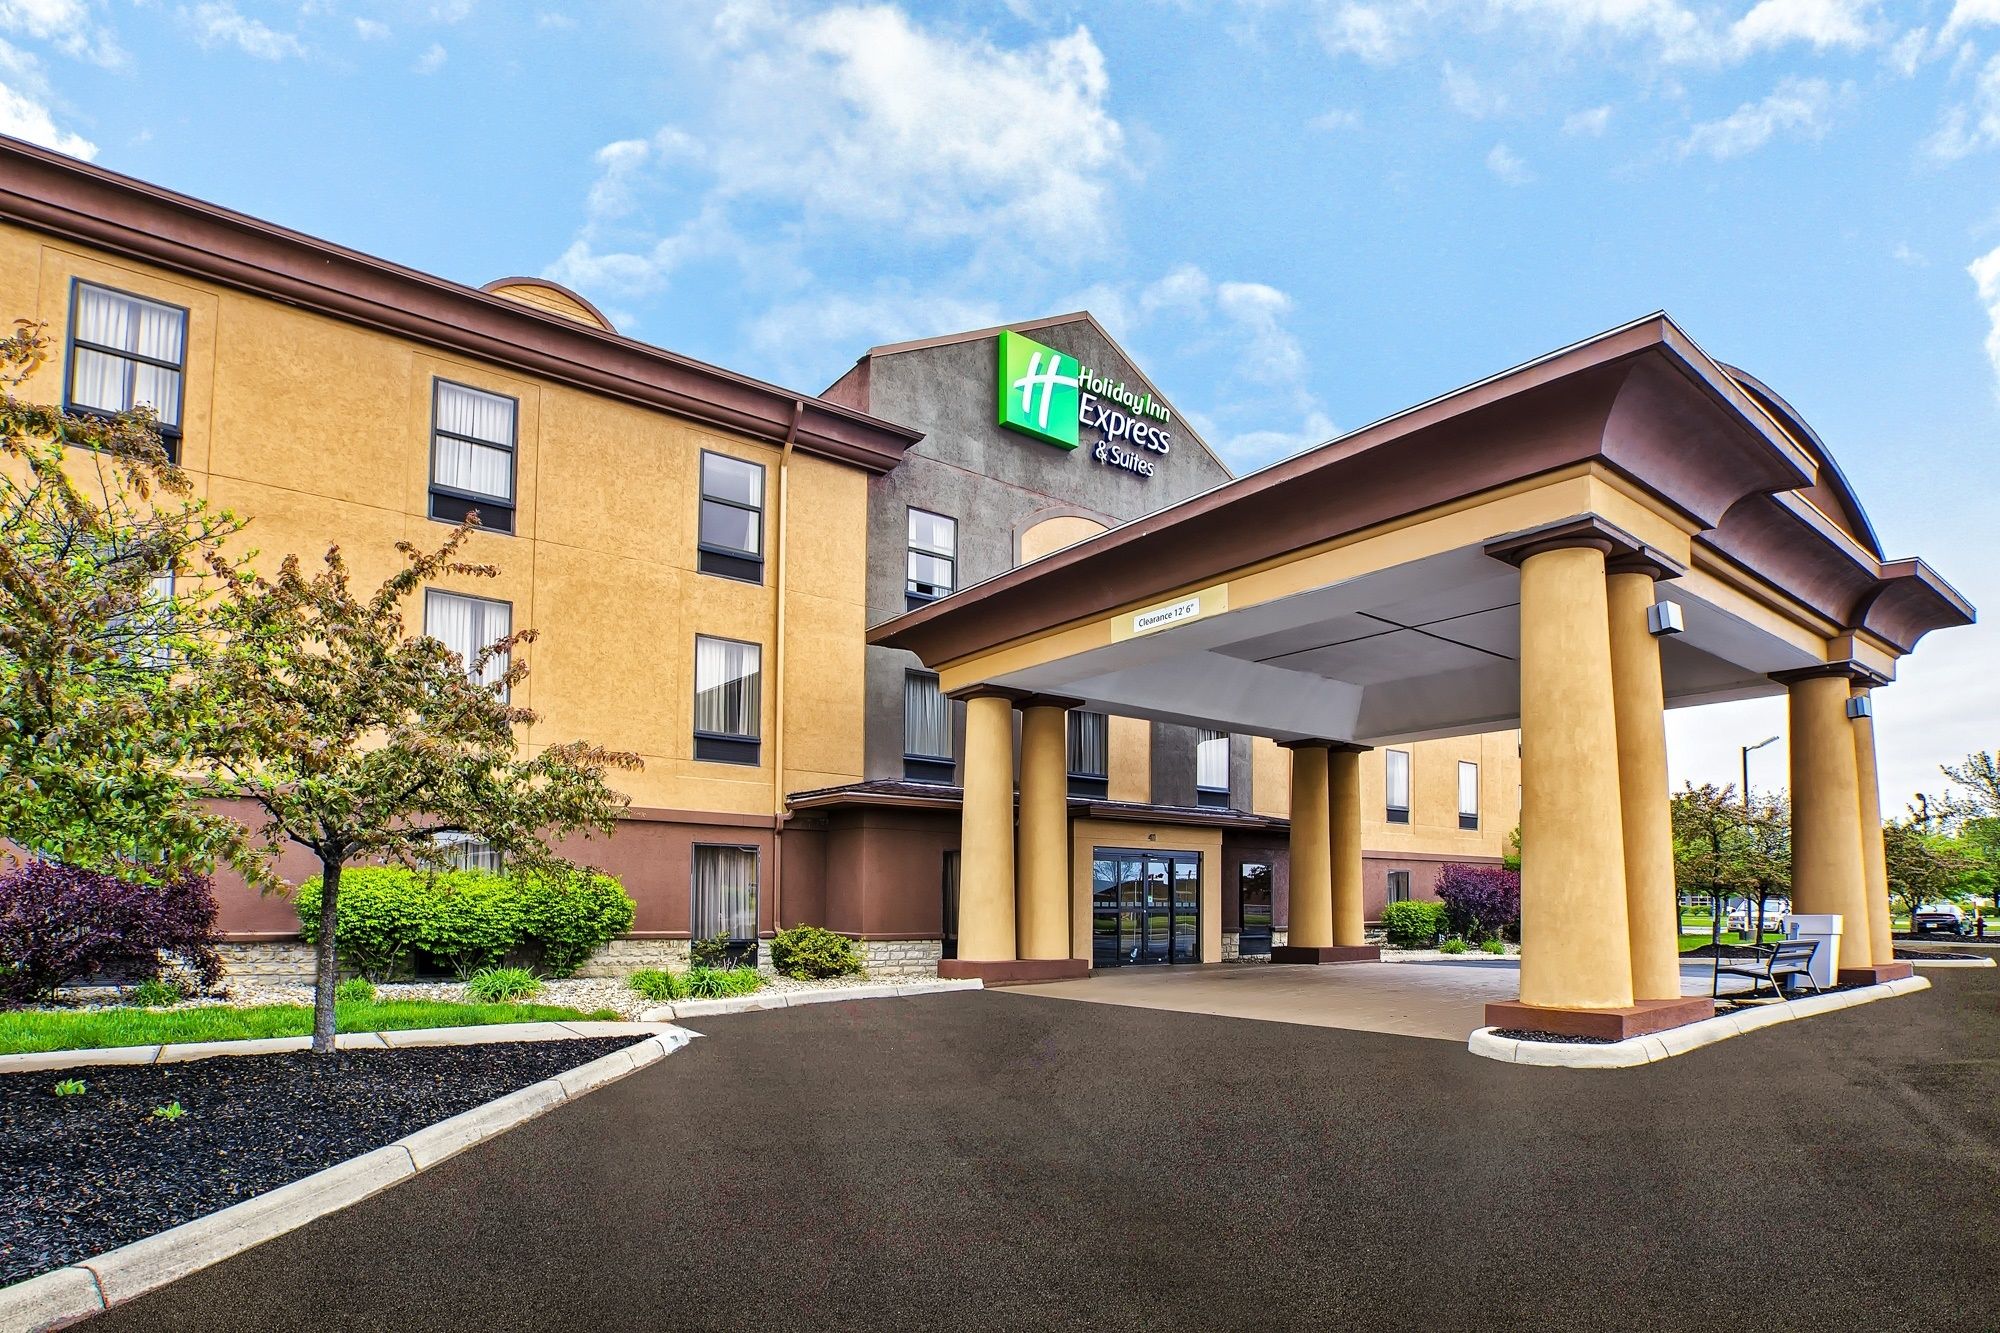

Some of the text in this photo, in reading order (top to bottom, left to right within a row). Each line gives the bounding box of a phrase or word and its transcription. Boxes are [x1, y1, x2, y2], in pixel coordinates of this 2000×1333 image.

[1078, 365, 1170, 423] Holiday Inn
[1079, 392, 1171, 454] Express
[1095, 440, 1154, 477] & Suites
[1138, 603, 1194, 627] Clearance 12' 6"
